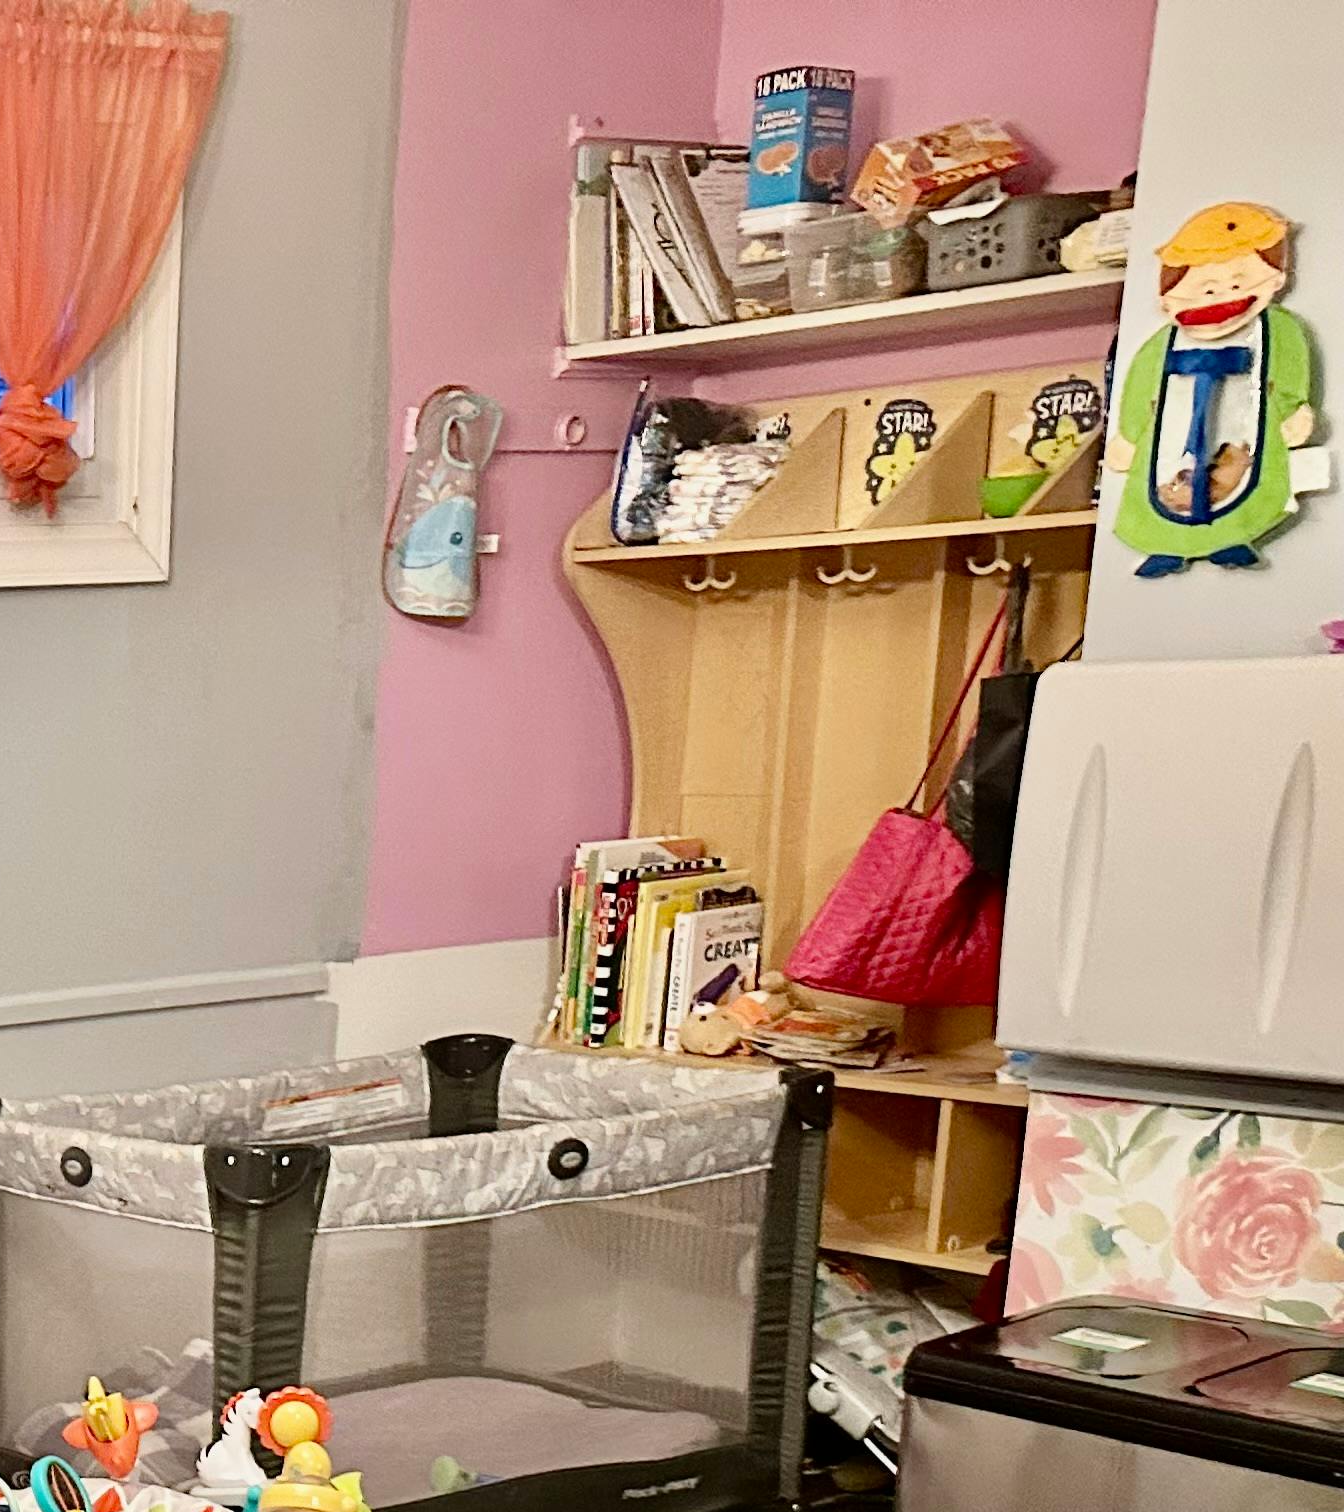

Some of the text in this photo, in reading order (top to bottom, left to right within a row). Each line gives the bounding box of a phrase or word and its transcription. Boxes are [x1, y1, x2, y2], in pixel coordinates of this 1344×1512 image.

[773, 68, 808, 94] PACK
[1036, 391, 1095, 420] STAR!
[881, 411, 929, 435] STAR!
